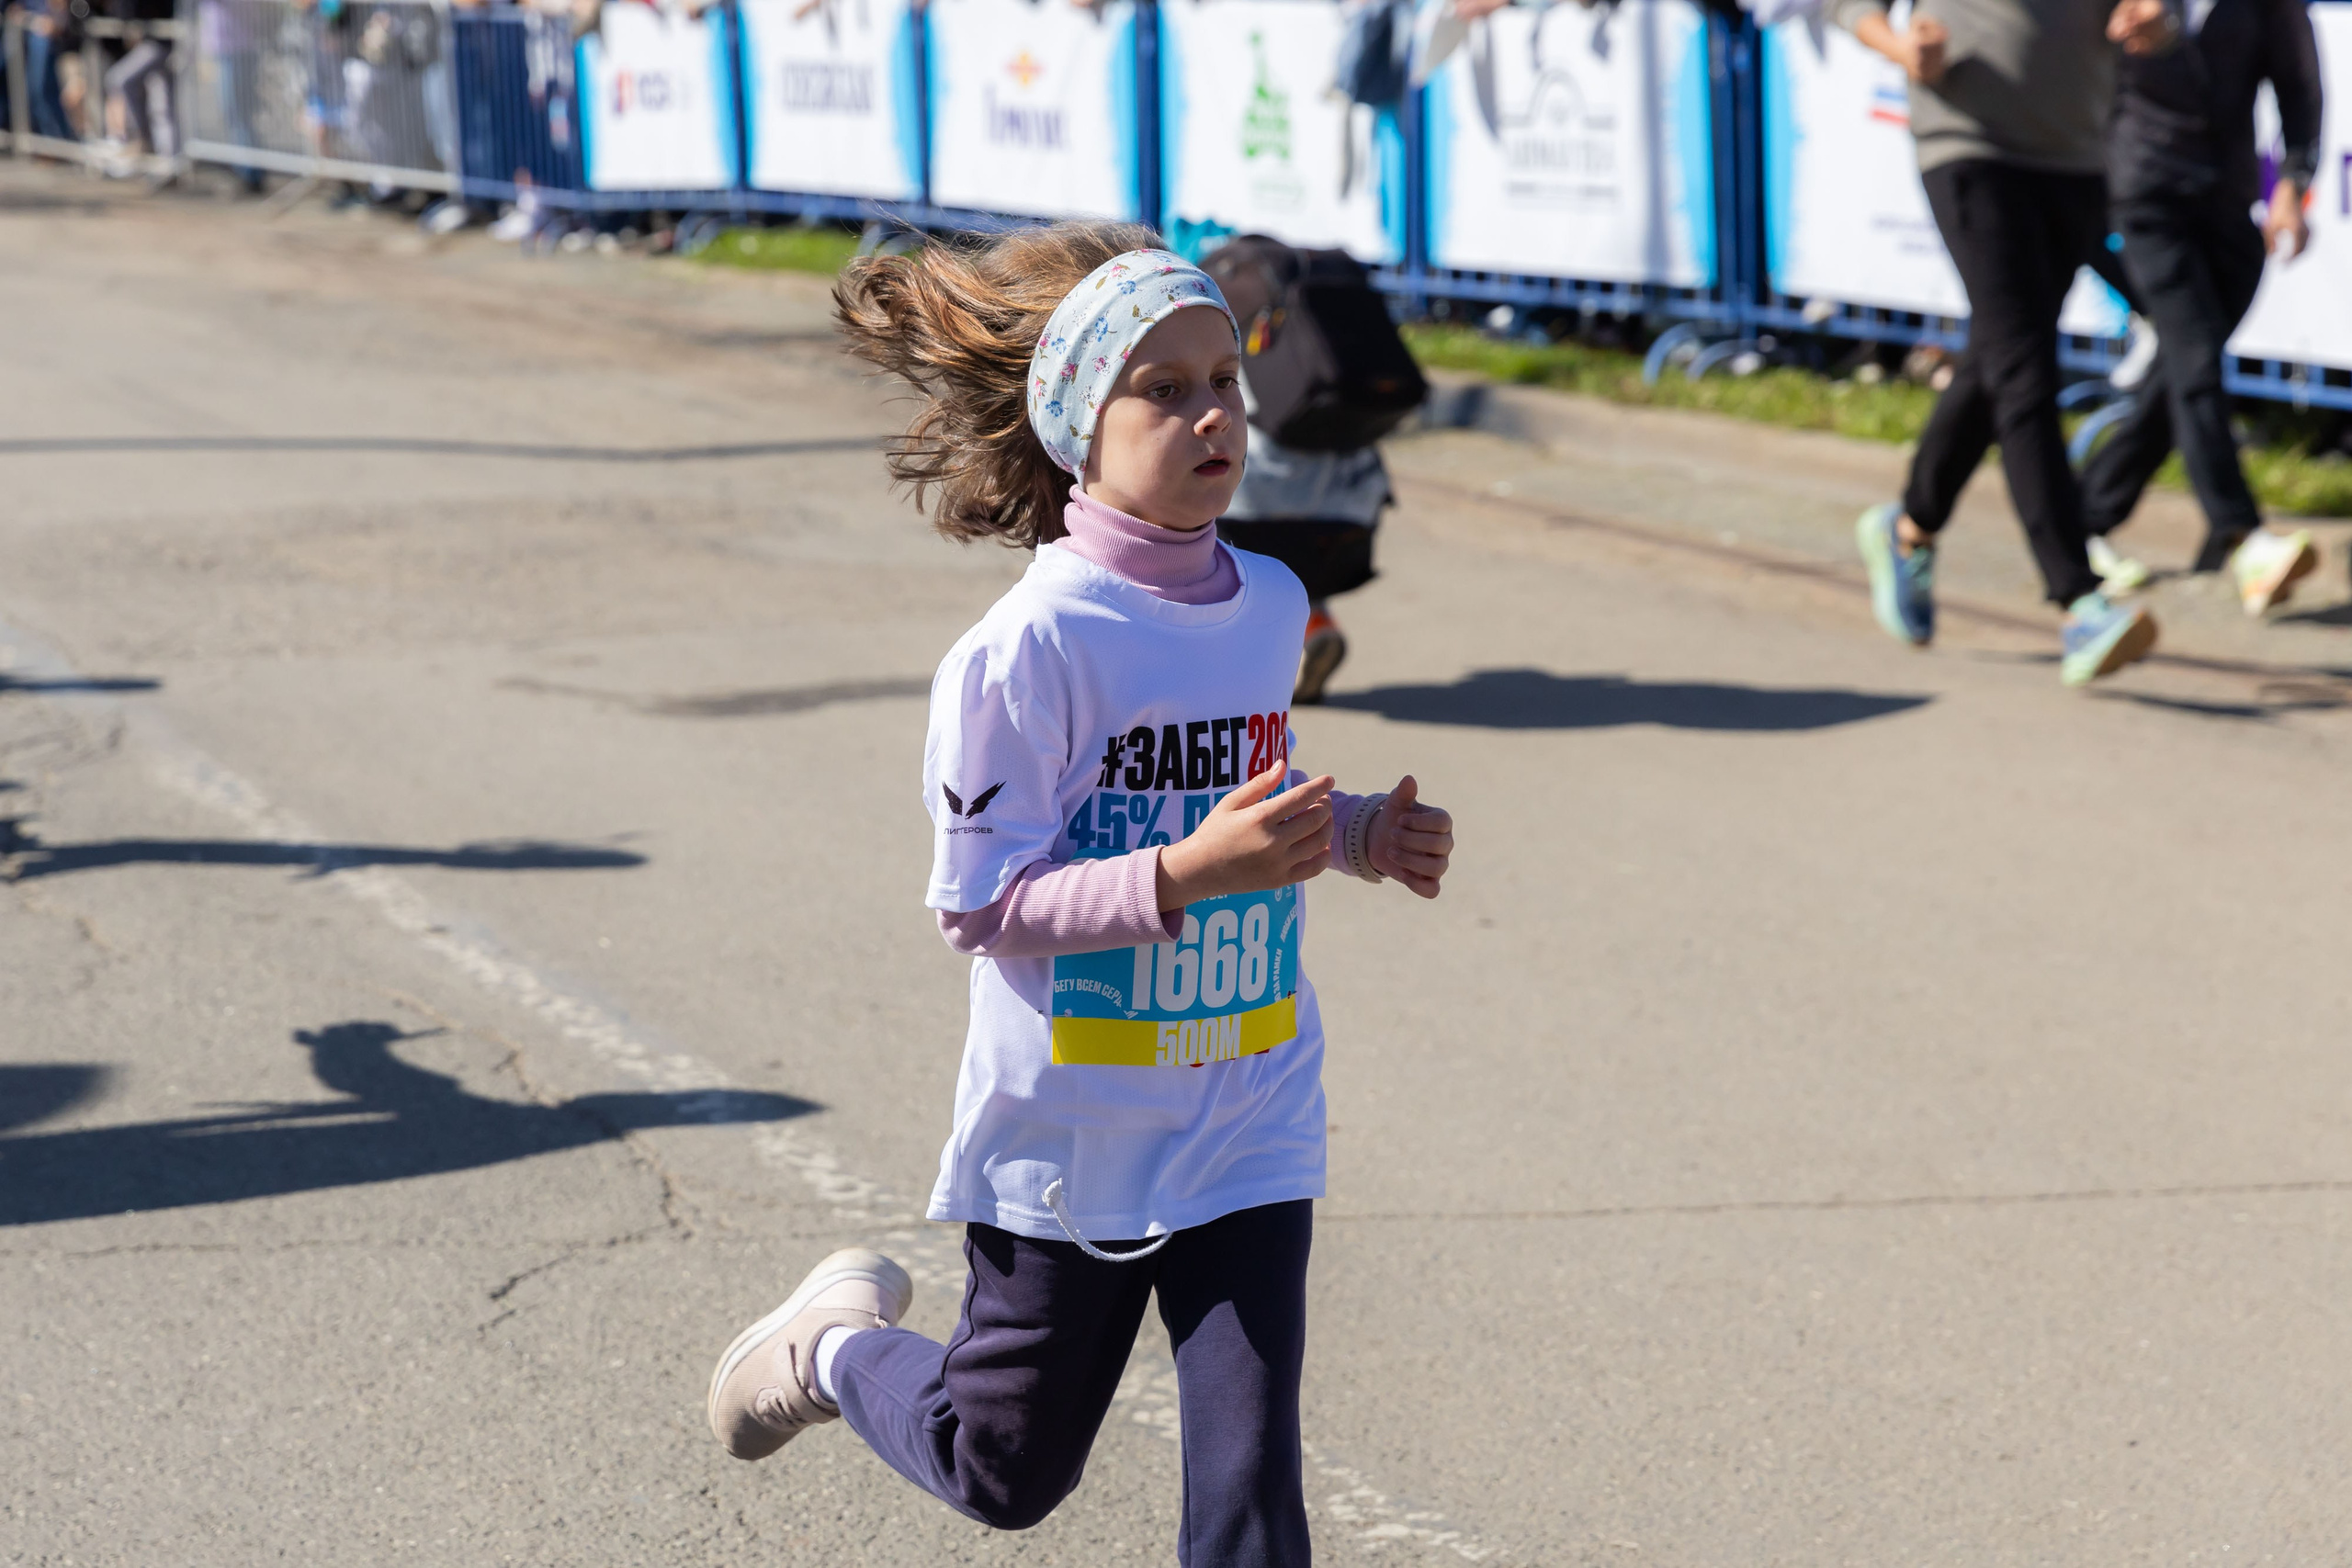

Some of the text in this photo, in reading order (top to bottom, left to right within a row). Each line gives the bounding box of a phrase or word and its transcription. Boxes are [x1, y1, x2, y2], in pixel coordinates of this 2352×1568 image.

[1068, 791, 1171, 851] 45%
[1131, 902, 1270, 1012] 1668
[1272, 948, 1283, 980] РАМКИ
[1054, 978, 1139, 1020] БЕГУ ВСЕМ СЕРДМ
[1155, 1013, 1241, 1066] 500М
